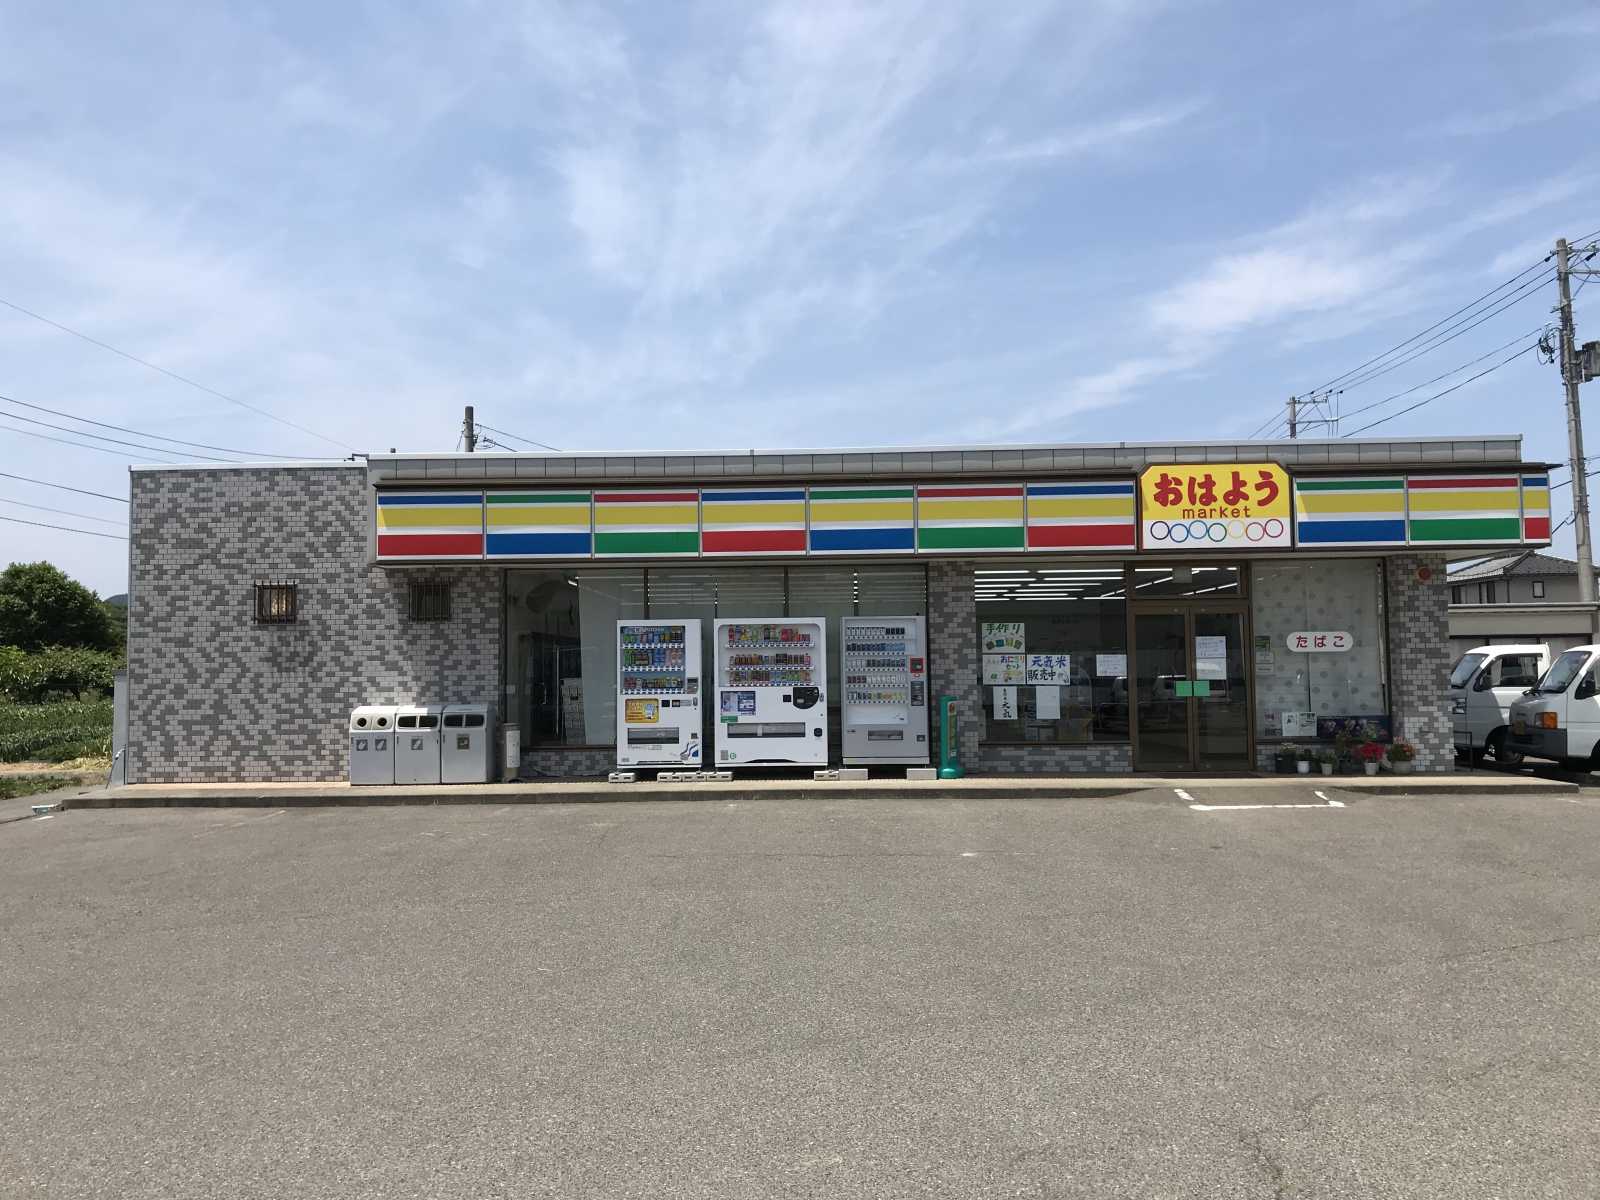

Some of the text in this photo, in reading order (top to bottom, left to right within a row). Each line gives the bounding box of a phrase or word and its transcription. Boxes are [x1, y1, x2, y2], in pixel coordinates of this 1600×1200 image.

[1153, 470, 1279, 507] おはよう
[1182, 506, 1251, 519] market
[984, 623, 1021, 635] 手作り
[1296, 635, 1345, 649] たばこ
[1027, 668, 1056, 682] 販売中
